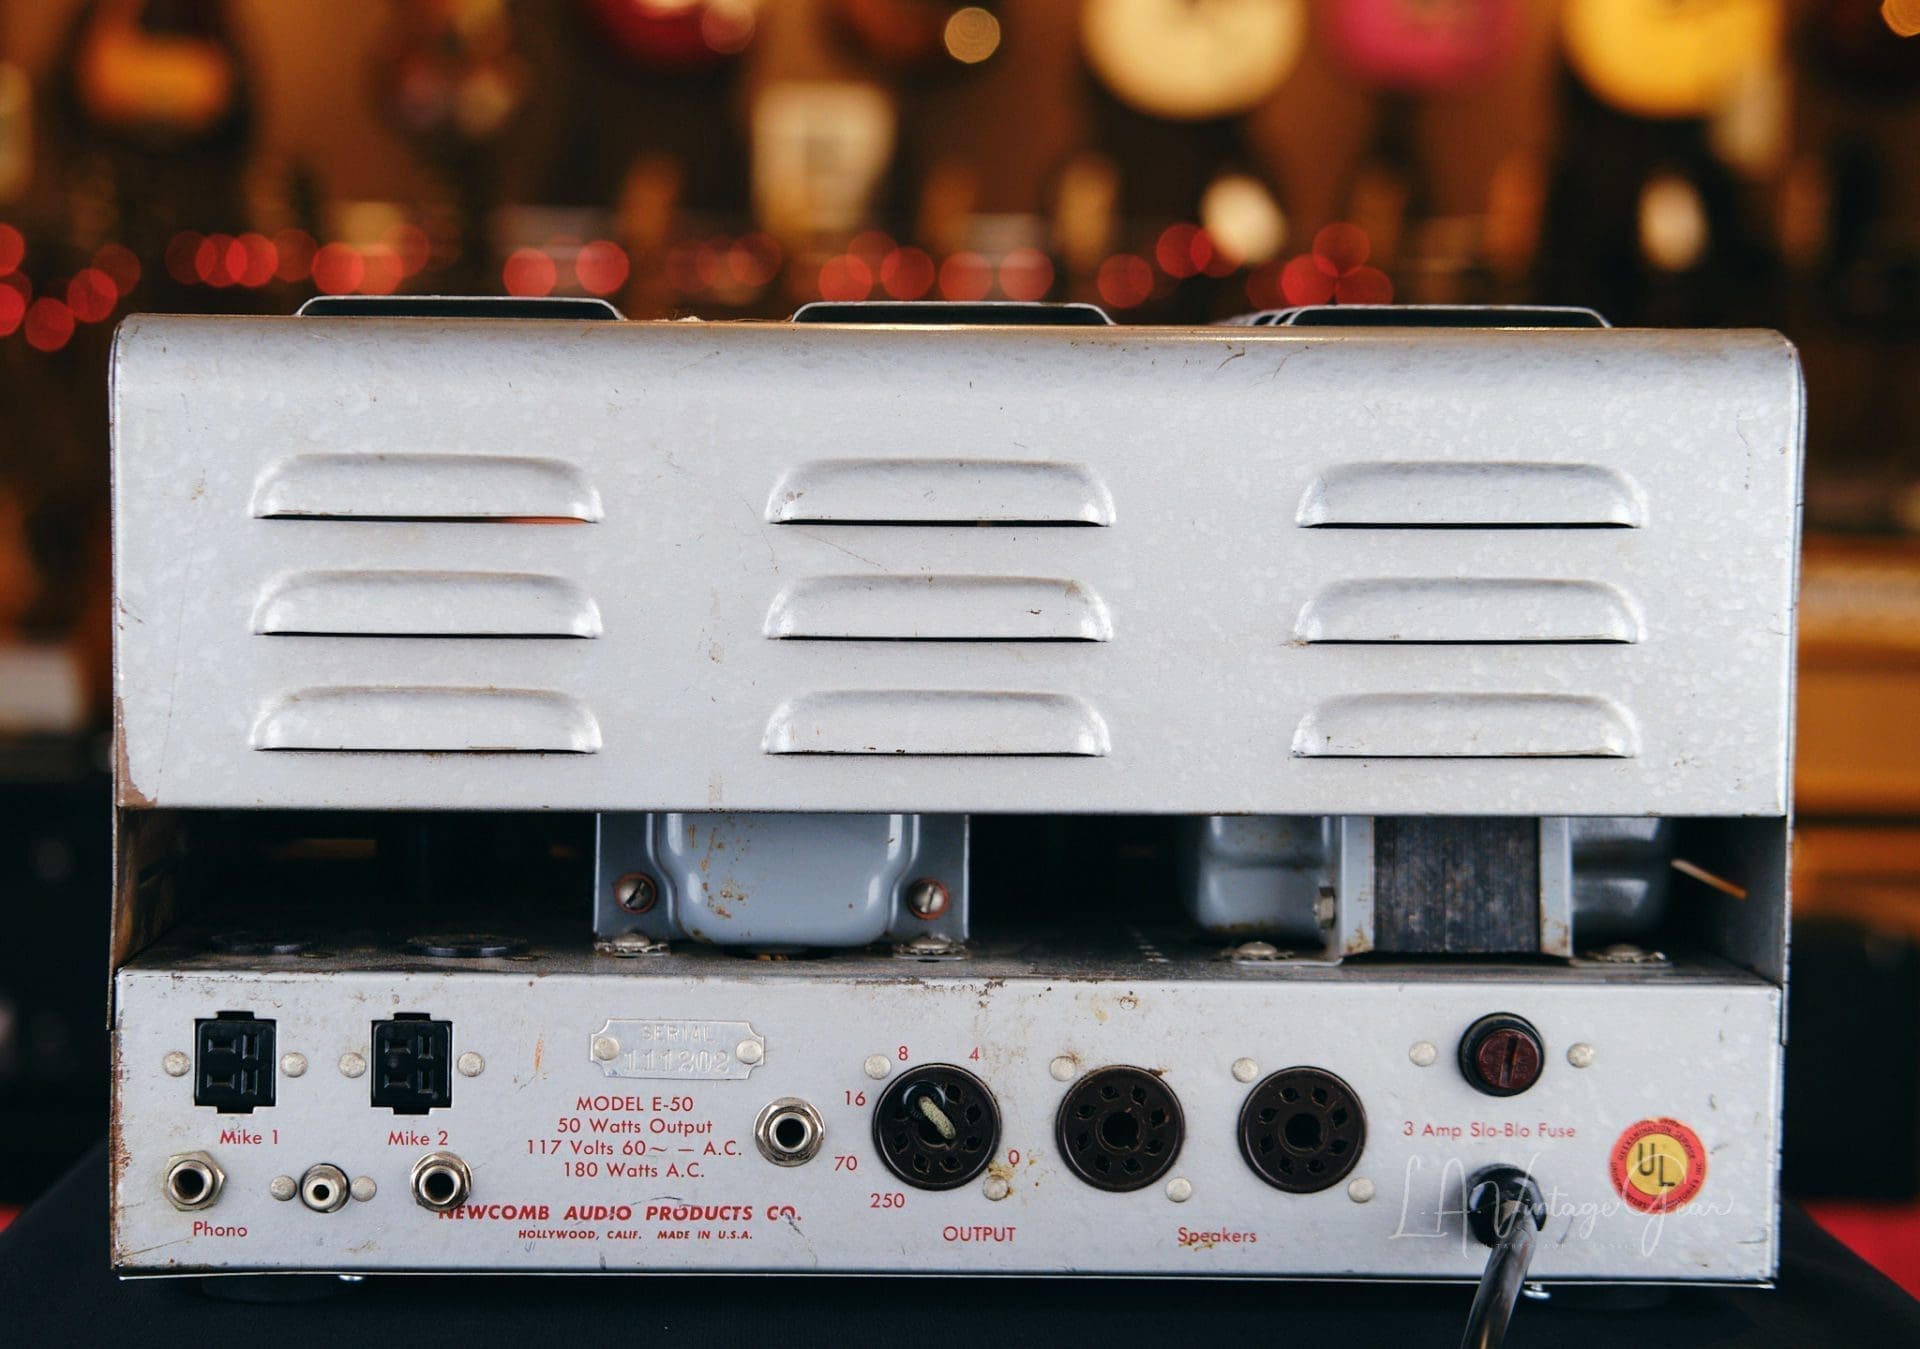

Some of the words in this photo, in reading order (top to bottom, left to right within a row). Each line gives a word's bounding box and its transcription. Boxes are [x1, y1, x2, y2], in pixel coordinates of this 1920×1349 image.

[641, 1023, 713, 1041] SERIAL
[896, 1044, 910, 1062] 8
[969, 1046, 981, 1062] 4
[575, 1094, 645, 1113] MODEL
[650, 1094, 695, 1113] E-50
[845, 1088, 868, 1108] 16
[557, 1115, 581, 1134] 50
[589, 1118, 642, 1135] Watts
[649, 1117, 714, 1138] Output
[1403, 1122, 1414, 1137] 3
[1421, 1123, 1463, 1140] Amp
[1470, 1121, 1532, 1138] Slo-Blo
[1537, 1122, 1577, 1138] Fuse
[218, 1128, 263, 1147] Mike
[271, 1127, 280, 1146] 1
[386, 1130, 432, 1146] Mike
[437, 1129, 449, 1147] 2
[527, 1138, 563, 1155] 117
[570, 1138, 614, 1156] Volts
[703, 1139, 743, 1157] A.C.
[834, 1153, 859, 1173] 70
[1007, 1148, 1021, 1167] 0
[1637, 1142, 1676, 1187] UL
[564, 1161, 599, 1179] 180
[606, 1163, 659, 1179] Watts
[666, 1161, 706, 1179] A.C.
[869, 1190, 907, 1210] 250
[438, 1201, 552, 1223] NEWCOMB
[563, 1203, 634, 1223] AUDIO
[643, 1203, 753, 1222] PRODUCTS
[764, 1202, 803, 1224] CO.
[191, 1219, 249, 1238] Phono
[517, 1229, 600, 1242] HOLLYWOOD,
[606, 1229, 643, 1241] CALIF.
[656, 1230, 690, 1241] MADE
[697, 1229, 713, 1240] IN
[716, 1229, 752, 1240] U.S.A.
[942, 1223, 1017, 1244] OUTPUT
[1176, 1225, 1258, 1247] Speakers
